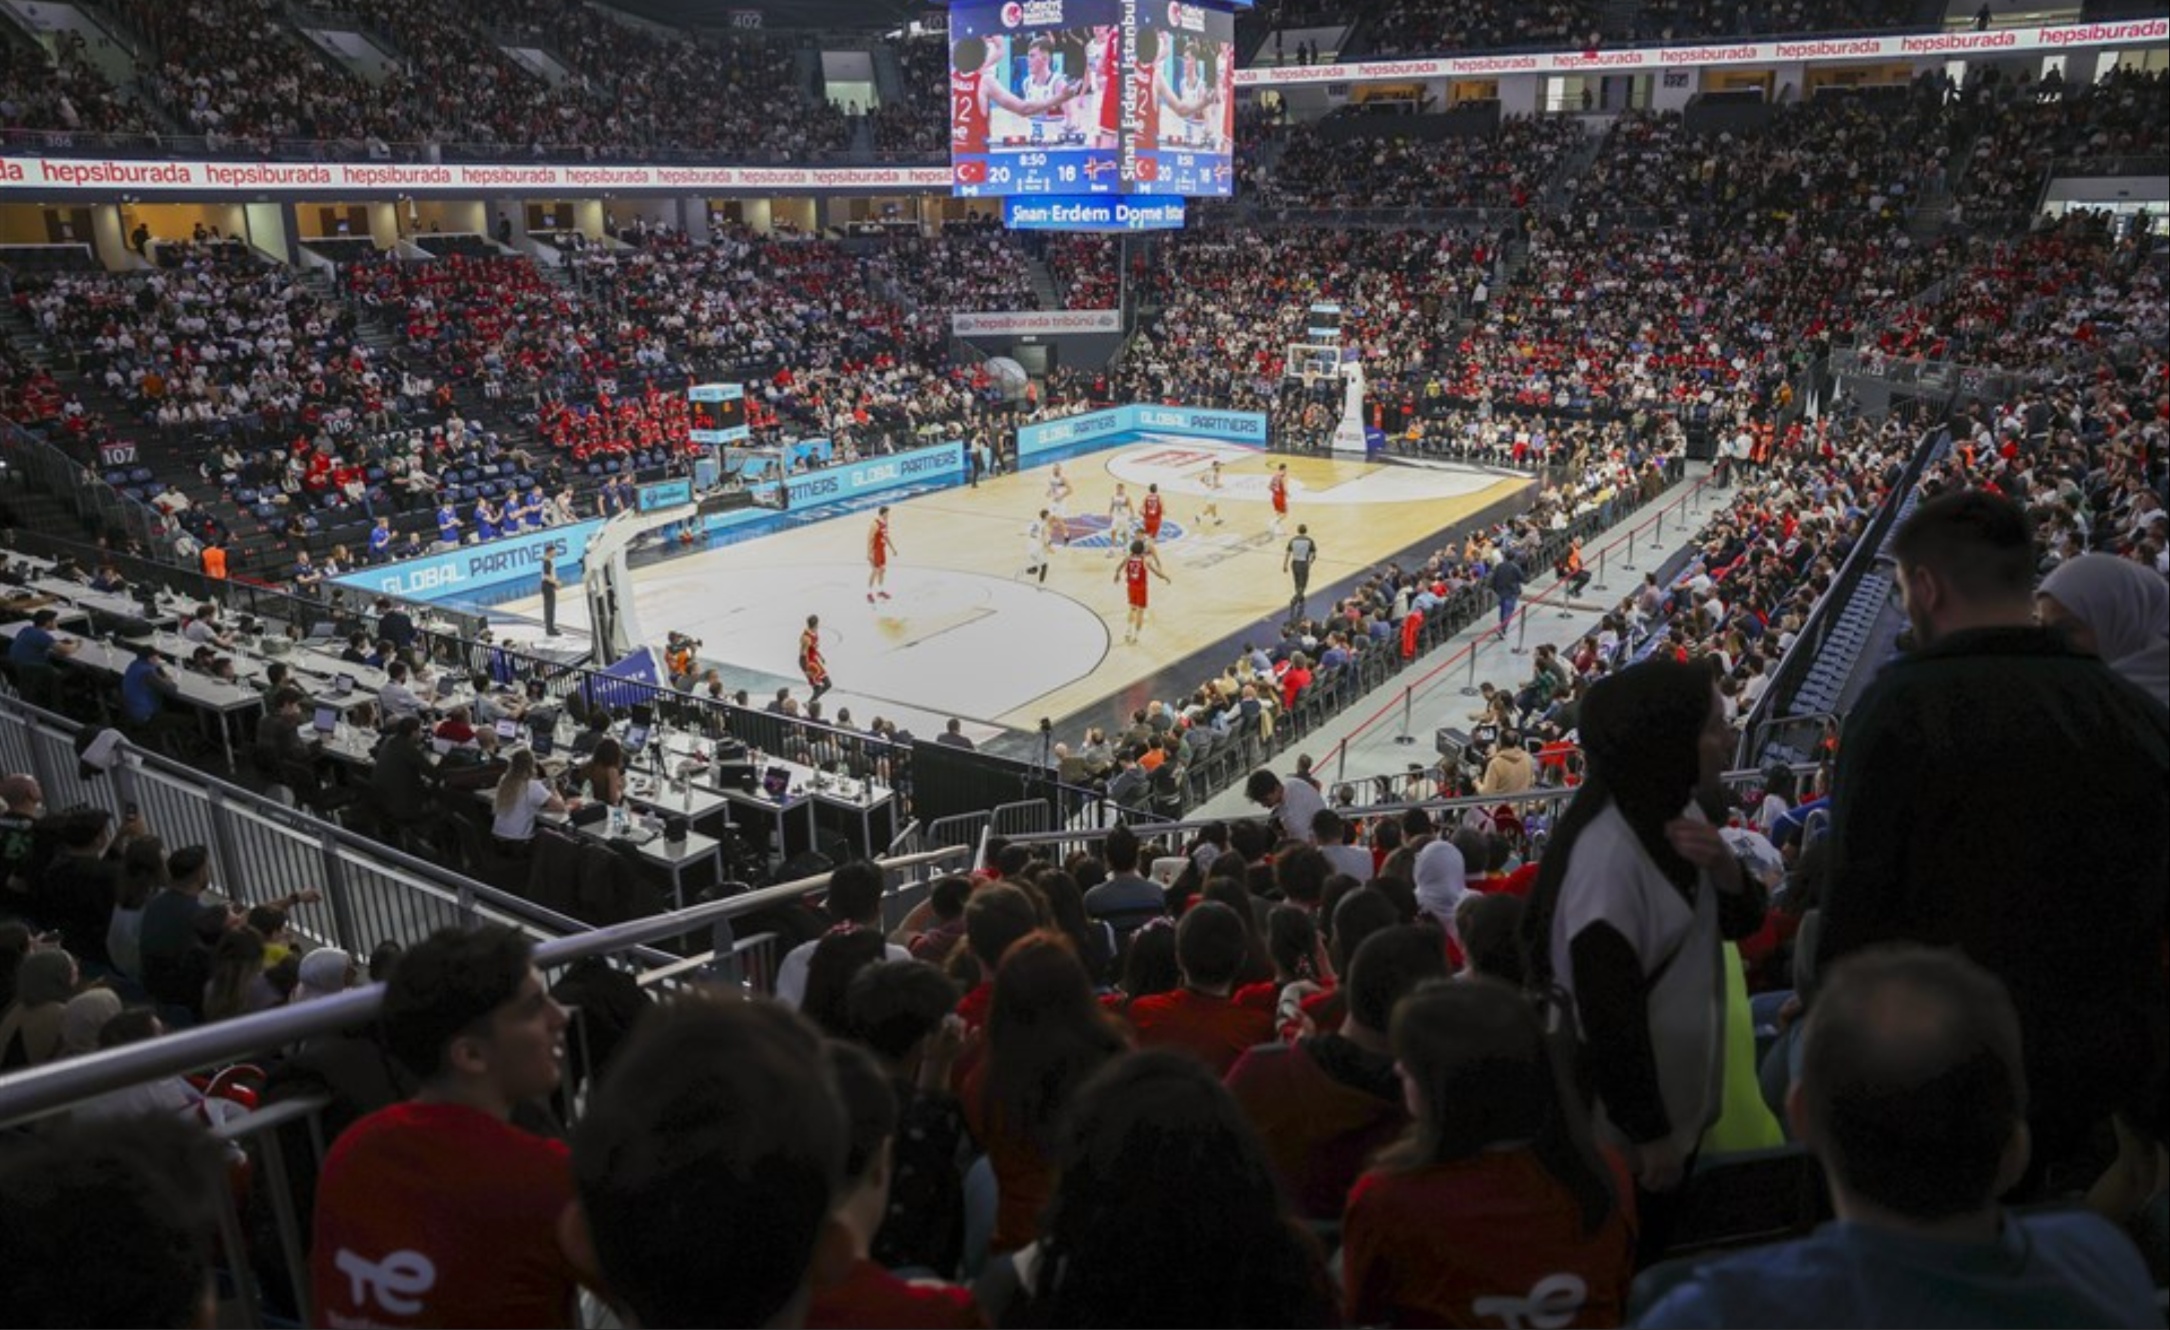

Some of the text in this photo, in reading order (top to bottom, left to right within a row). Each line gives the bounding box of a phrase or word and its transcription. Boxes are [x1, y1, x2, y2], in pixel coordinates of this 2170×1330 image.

[1358, 61, 1437, 78] hepsiburada
[1453, 56, 1536, 73] hepsiburada
[1661, 46, 1757, 63] hepsiburada
[1776, 39, 1880, 58] hepsiburada
[1901, 30, 2016, 52] hepsiburada
[2039, 20, 2168, 45] hepsiburada
[1121, 74, 1135, 129] Erdem
[1121, 133, 1135, 181] Sinan
[42, 160, 192, 185] hepsiburada
[206, 164, 331, 187] hepsiburada
[343, 165, 451, 186] hepsiburada
[462, 166, 556, 186] hepsiburada
[566, 167, 649, 186] hepsiburada
[812, 168, 900, 185] hepsiburada
[989, 167, 1010, 183] 20
[1052, 204, 1110, 222] Erdem
[976, 317, 1049, 329] hepsiburada
[1074, 416, 1116, 435] PARTNERS
[1140, 411, 1258, 433] GLOBAL PARTNERS
[103, 446, 135, 464] 107
[851, 464, 898, 486] GLOBAL
[901, 450, 959, 476] PARTNERS
[382, 563, 465, 595] GLOBAL
